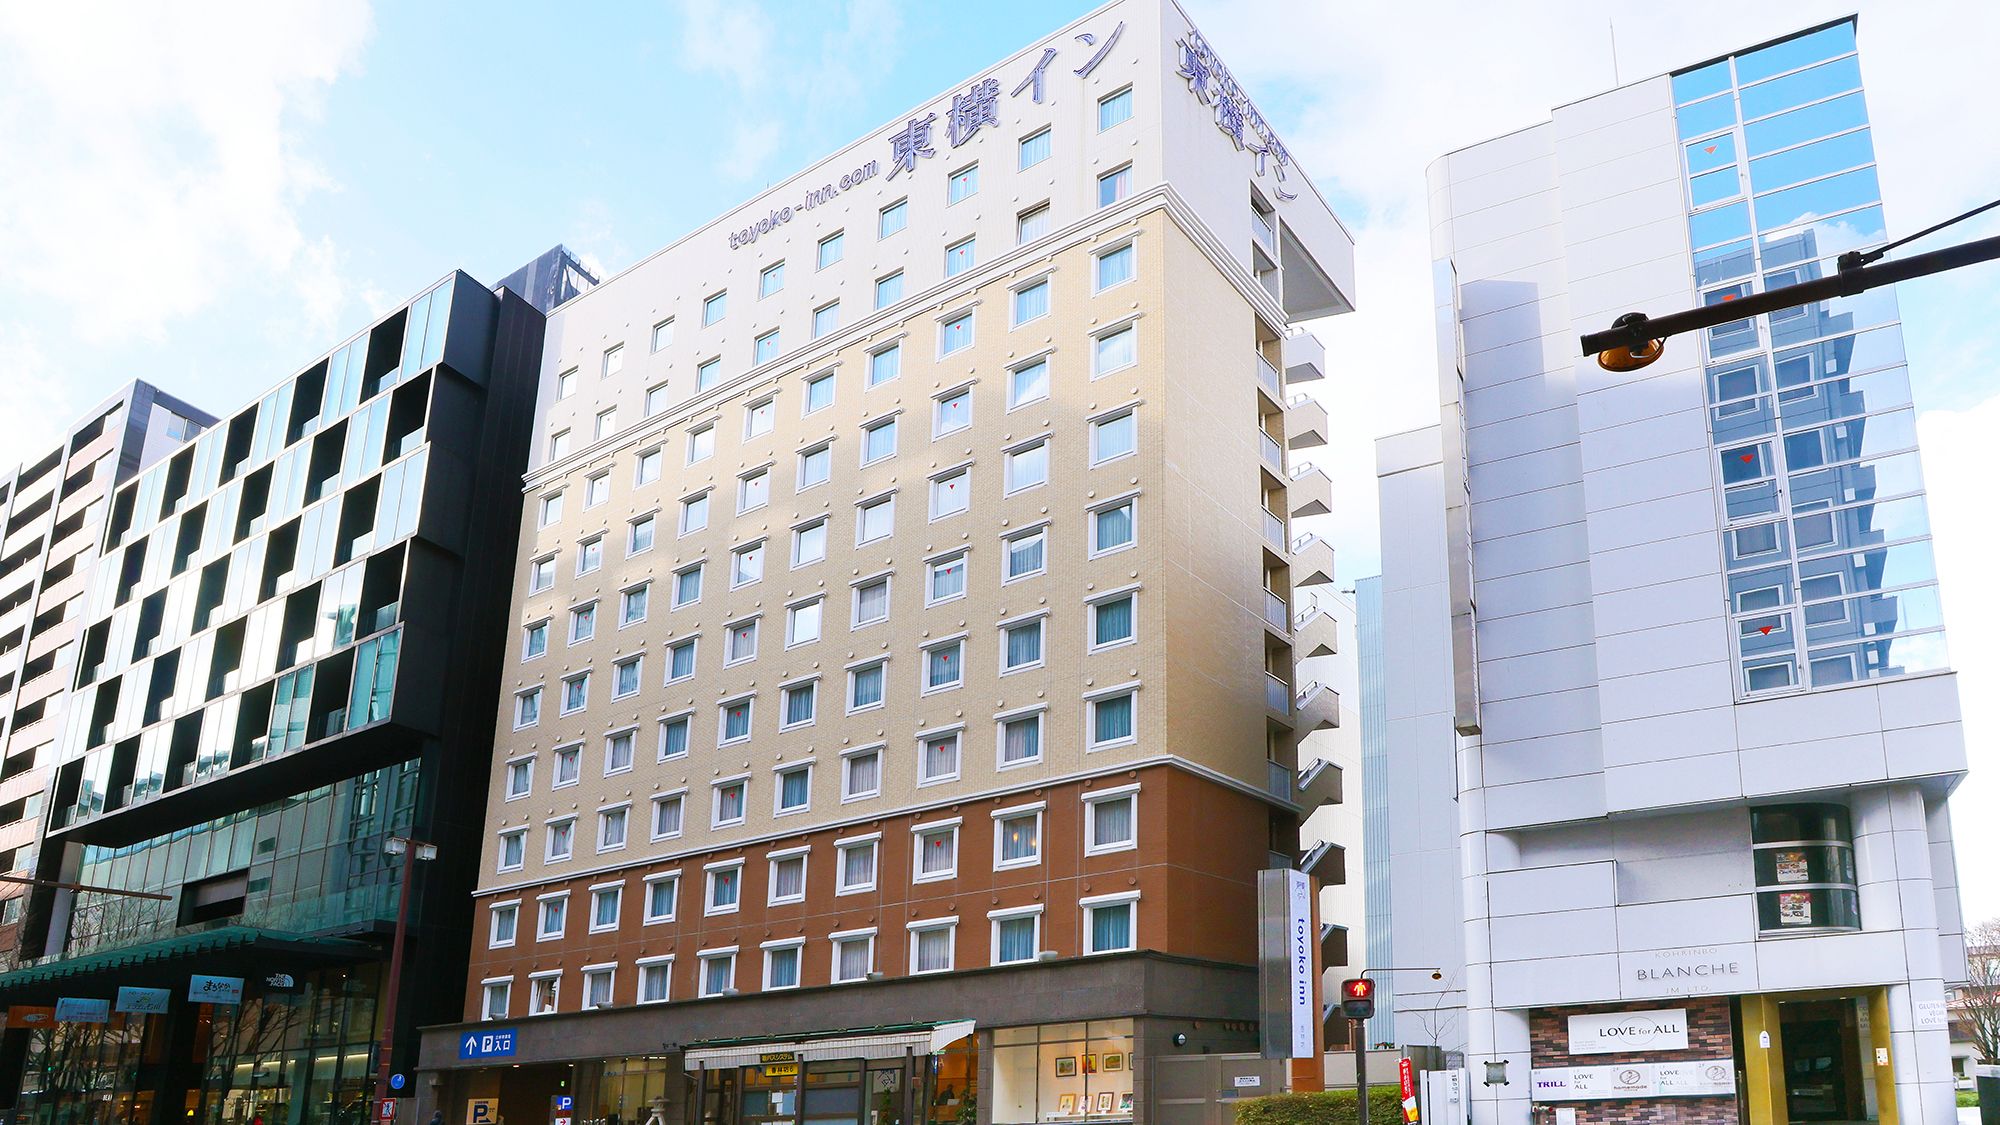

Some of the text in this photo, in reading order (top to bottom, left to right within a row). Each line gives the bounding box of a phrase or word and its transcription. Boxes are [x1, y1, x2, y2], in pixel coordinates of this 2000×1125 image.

[885, 20, 1124, 182] 東横イン
[1175, 38, 1298, 201] 東横イン
[728, 159, 878, 250] toyoko-inn.com
[1297, 917, 1307, 1006] toyoko inn
[1637, 962, 1739, 981] BLANCHE
[1599, 1027, 1636, 1037] LOVE
[1653, 1024, 1680, 1034] ALL
[494, 1040, 511, 1051] 入口
[562, 1097, 572, 1109] P
[473, 1104, 489, 1124] P
